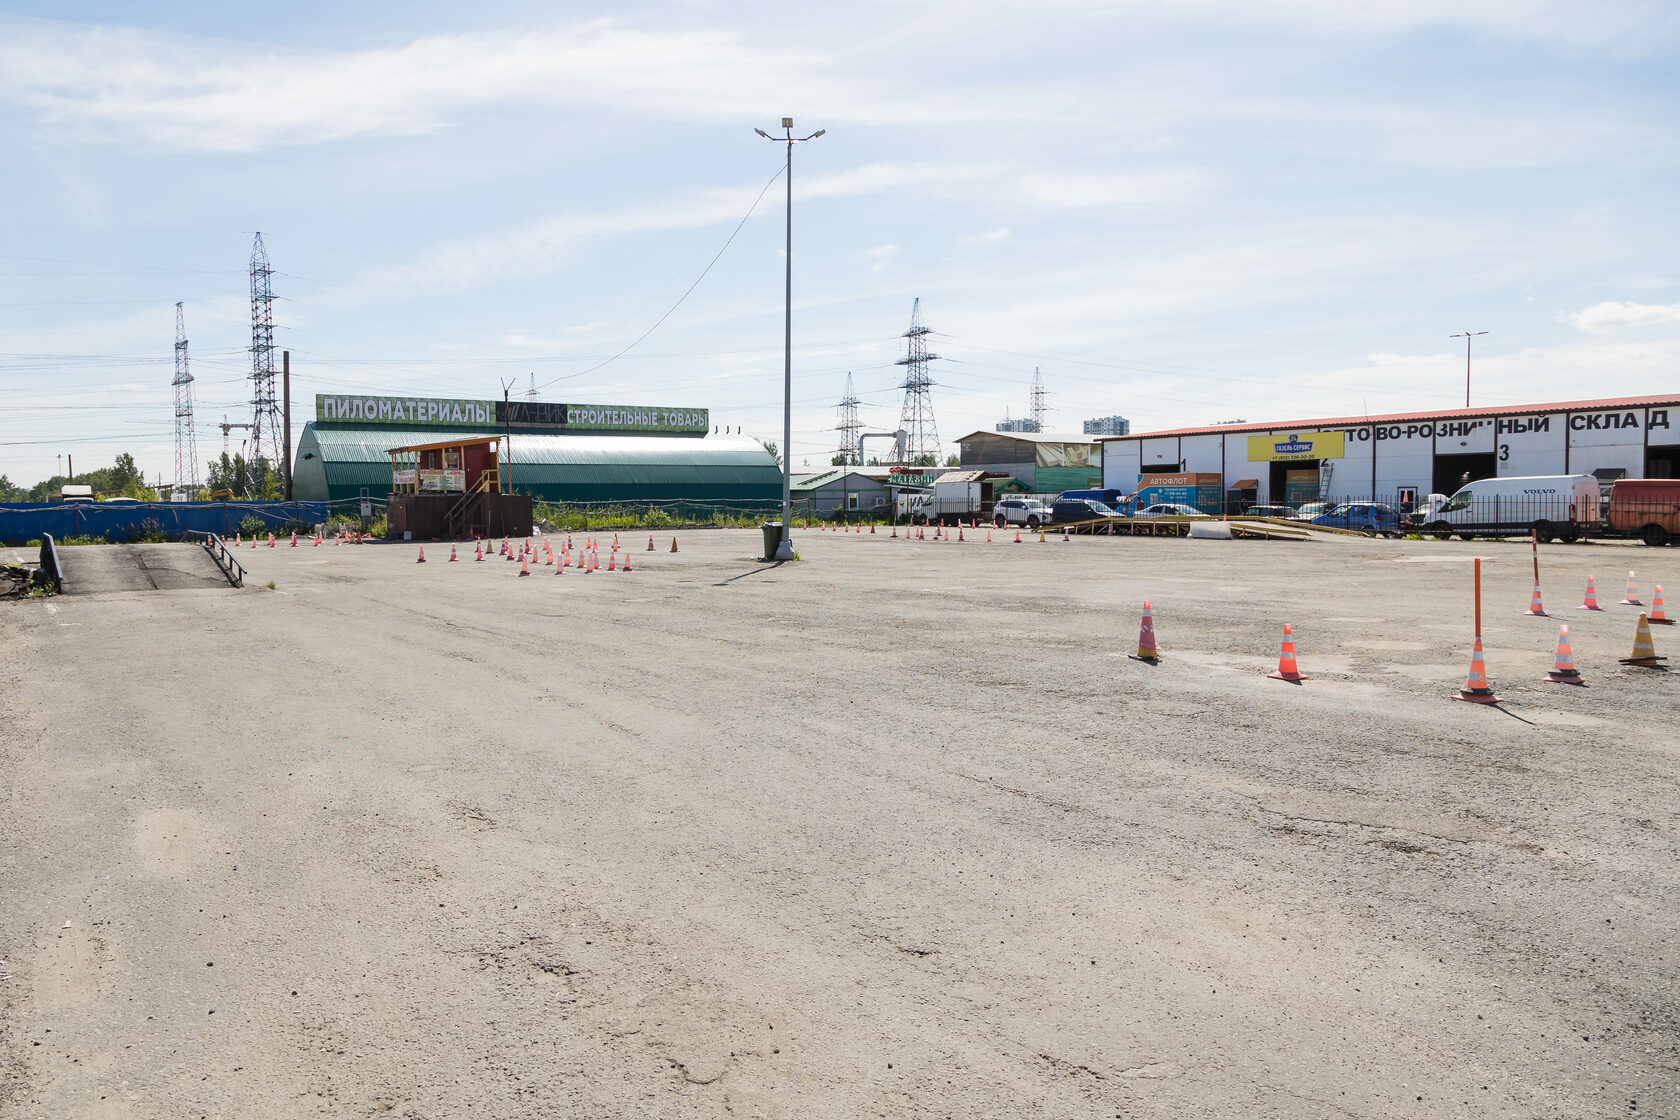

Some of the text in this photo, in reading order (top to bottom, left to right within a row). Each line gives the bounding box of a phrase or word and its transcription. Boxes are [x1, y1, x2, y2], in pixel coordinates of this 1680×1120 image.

[324, 398, 490, 423] ПИЛОМАТЕРИАЛЫ
[567, 409, 708, 427] СТРОИТЕЛЬНЫЕ ТОВАРЫ
[1570, 410, 1670, 433] СКЛАД
[1498, 444, 1509, 461] 3
[891, 474, 935, 484] МАГАЗИН
[1149, 477, 1188, 485] АВТОФЛОТ
